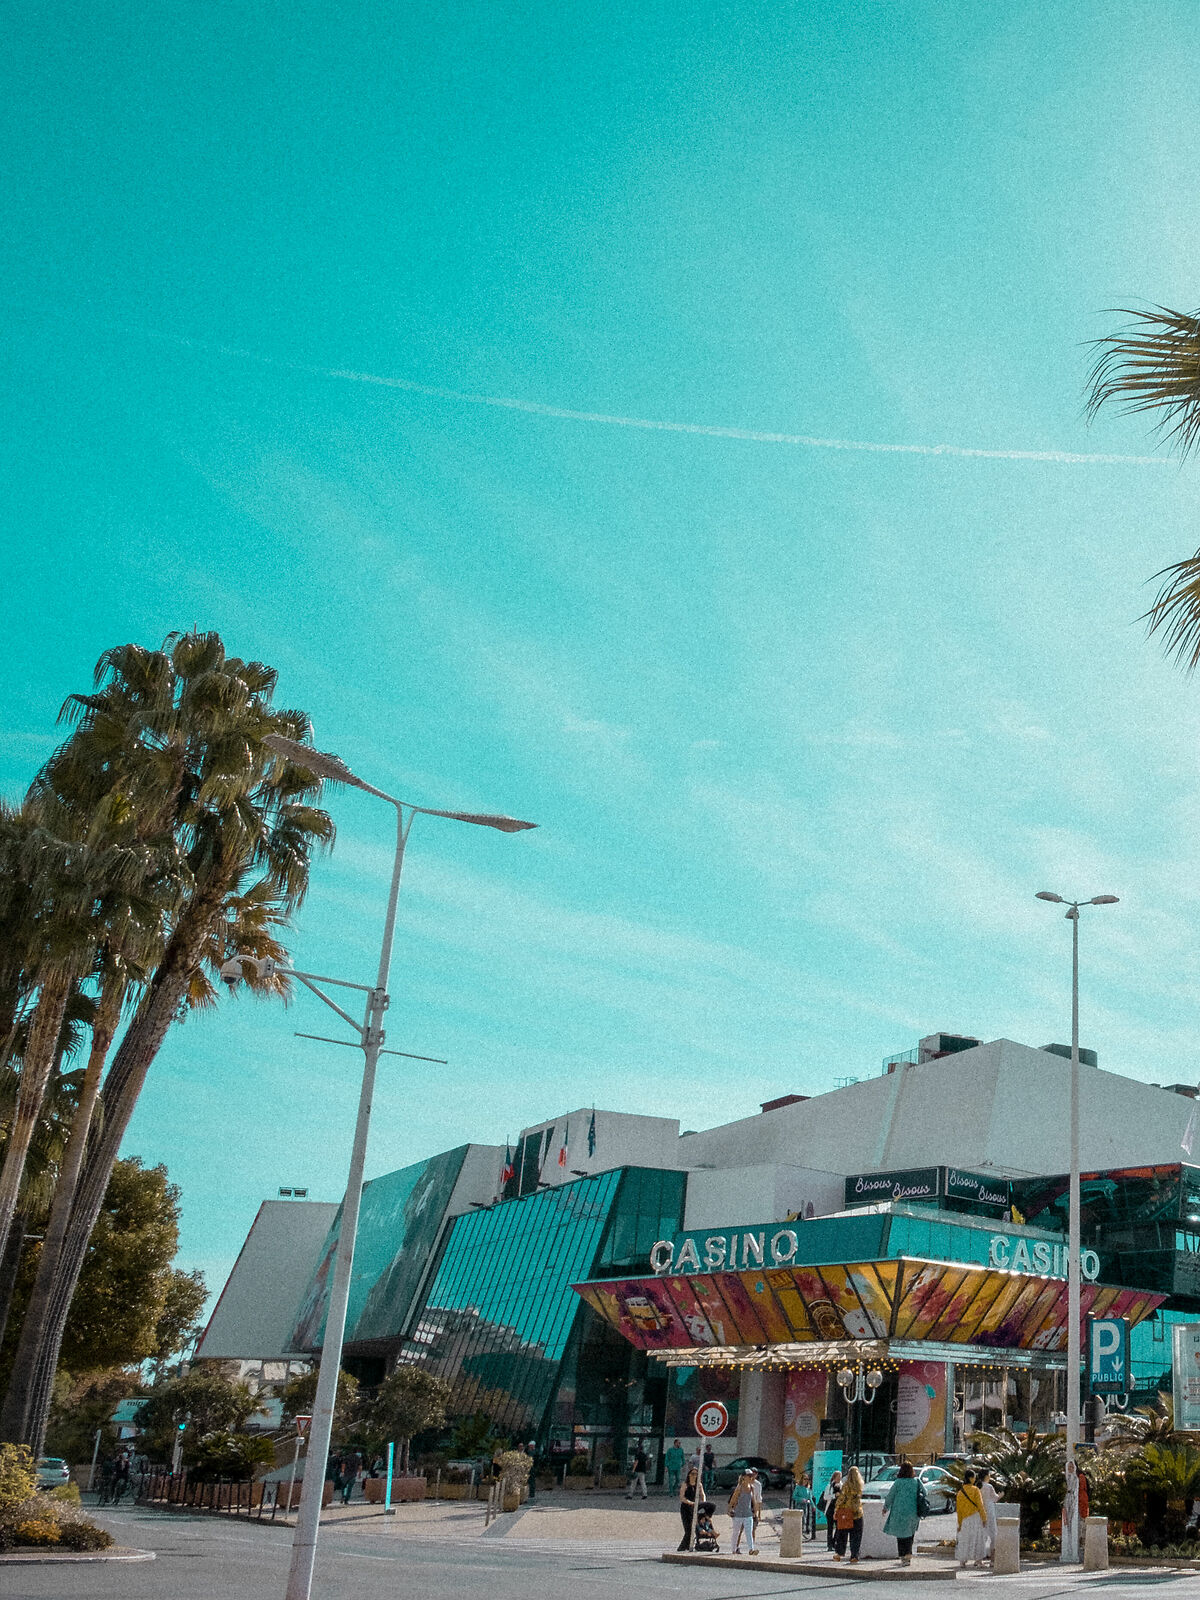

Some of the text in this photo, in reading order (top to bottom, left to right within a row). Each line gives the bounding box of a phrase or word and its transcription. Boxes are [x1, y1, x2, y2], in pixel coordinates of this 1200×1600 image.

[855, 1177, 892, 1193] Bisous
[892, 1182, 931, 1199] Bisous
[650, 1229, 799, 1272] CASINO
[1092, 1321, 1121, 1374] P
[1092, 1373, 1124, 1382] PUBLIC
[702, 1414, 720, 1427] 3,5t
